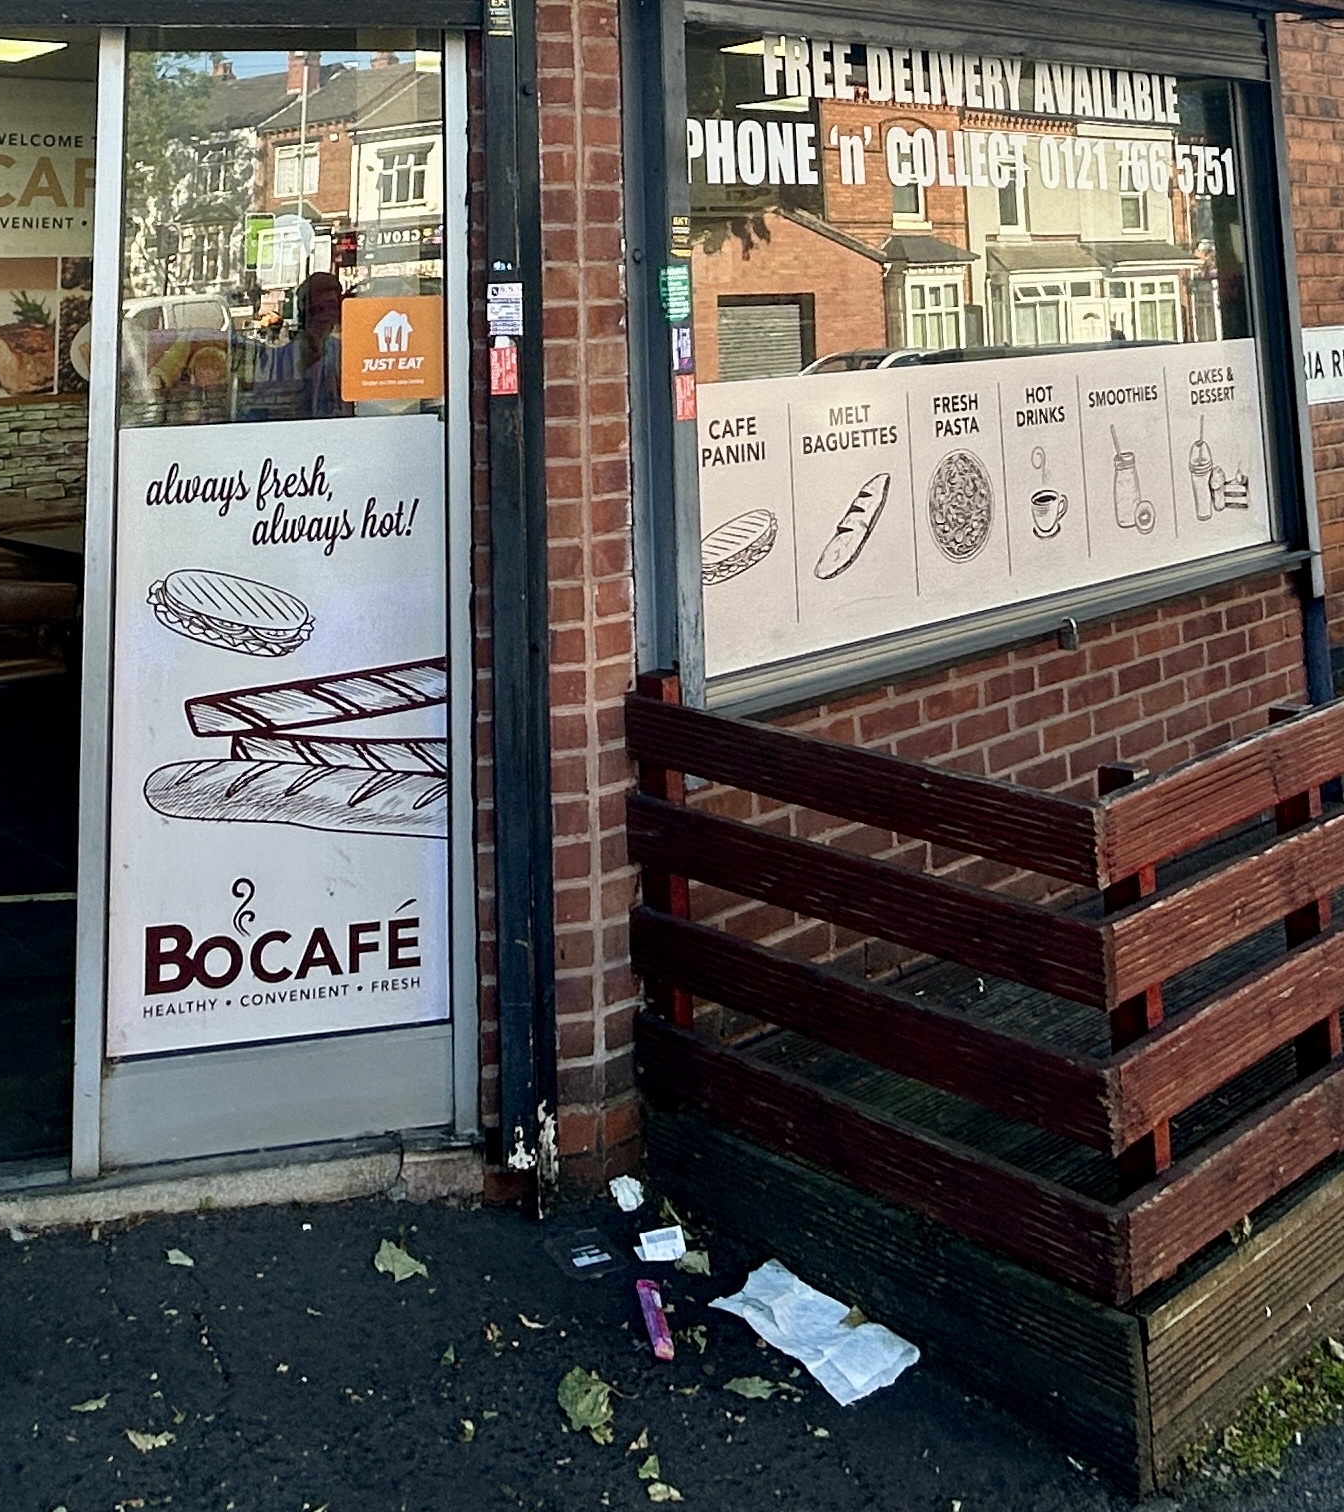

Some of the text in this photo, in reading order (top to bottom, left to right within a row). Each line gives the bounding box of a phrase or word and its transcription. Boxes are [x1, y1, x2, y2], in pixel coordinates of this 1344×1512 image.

[762, 36, 1181, 124] FREE DELIVERY AVAILABLE
[687, 117, 819, 185] PHONE
[886, 126, 1027, 189] COLLECT
[1040, 134, 1107, 190] 0121
[1115, 141, 1169, 193] 766
[1176, 143, 1236, 196] 5751
[361, 356, 425, 373] JUST EAT
[1188, 366, 1235, 386] CAKES &
[1303, 350, 1325, 380] IA
[932, 393, 979, 415] FRESH
[1025, 385, 1054, 404] HOT
[1088, 384, 1159, 408] SMOOTHIES
[1190, 385, 1236, 406] DESSERT
[829, 404, 871, 426] MELT
[1016, 405, 1066, 427] DRINKS
[709, 417, 757, 439] CAFE
[934, 416, 981, 438] PASTA
[802, 425, 898, 454] BAGUETTES
[702, 441, 766, 467] PANINI
[146, 455, 334, 516] always fresh,
[252, 497, 420, 557] always hot!
[143, 977, 421, 1018] HEALTHY CONVENIENT FRESH
